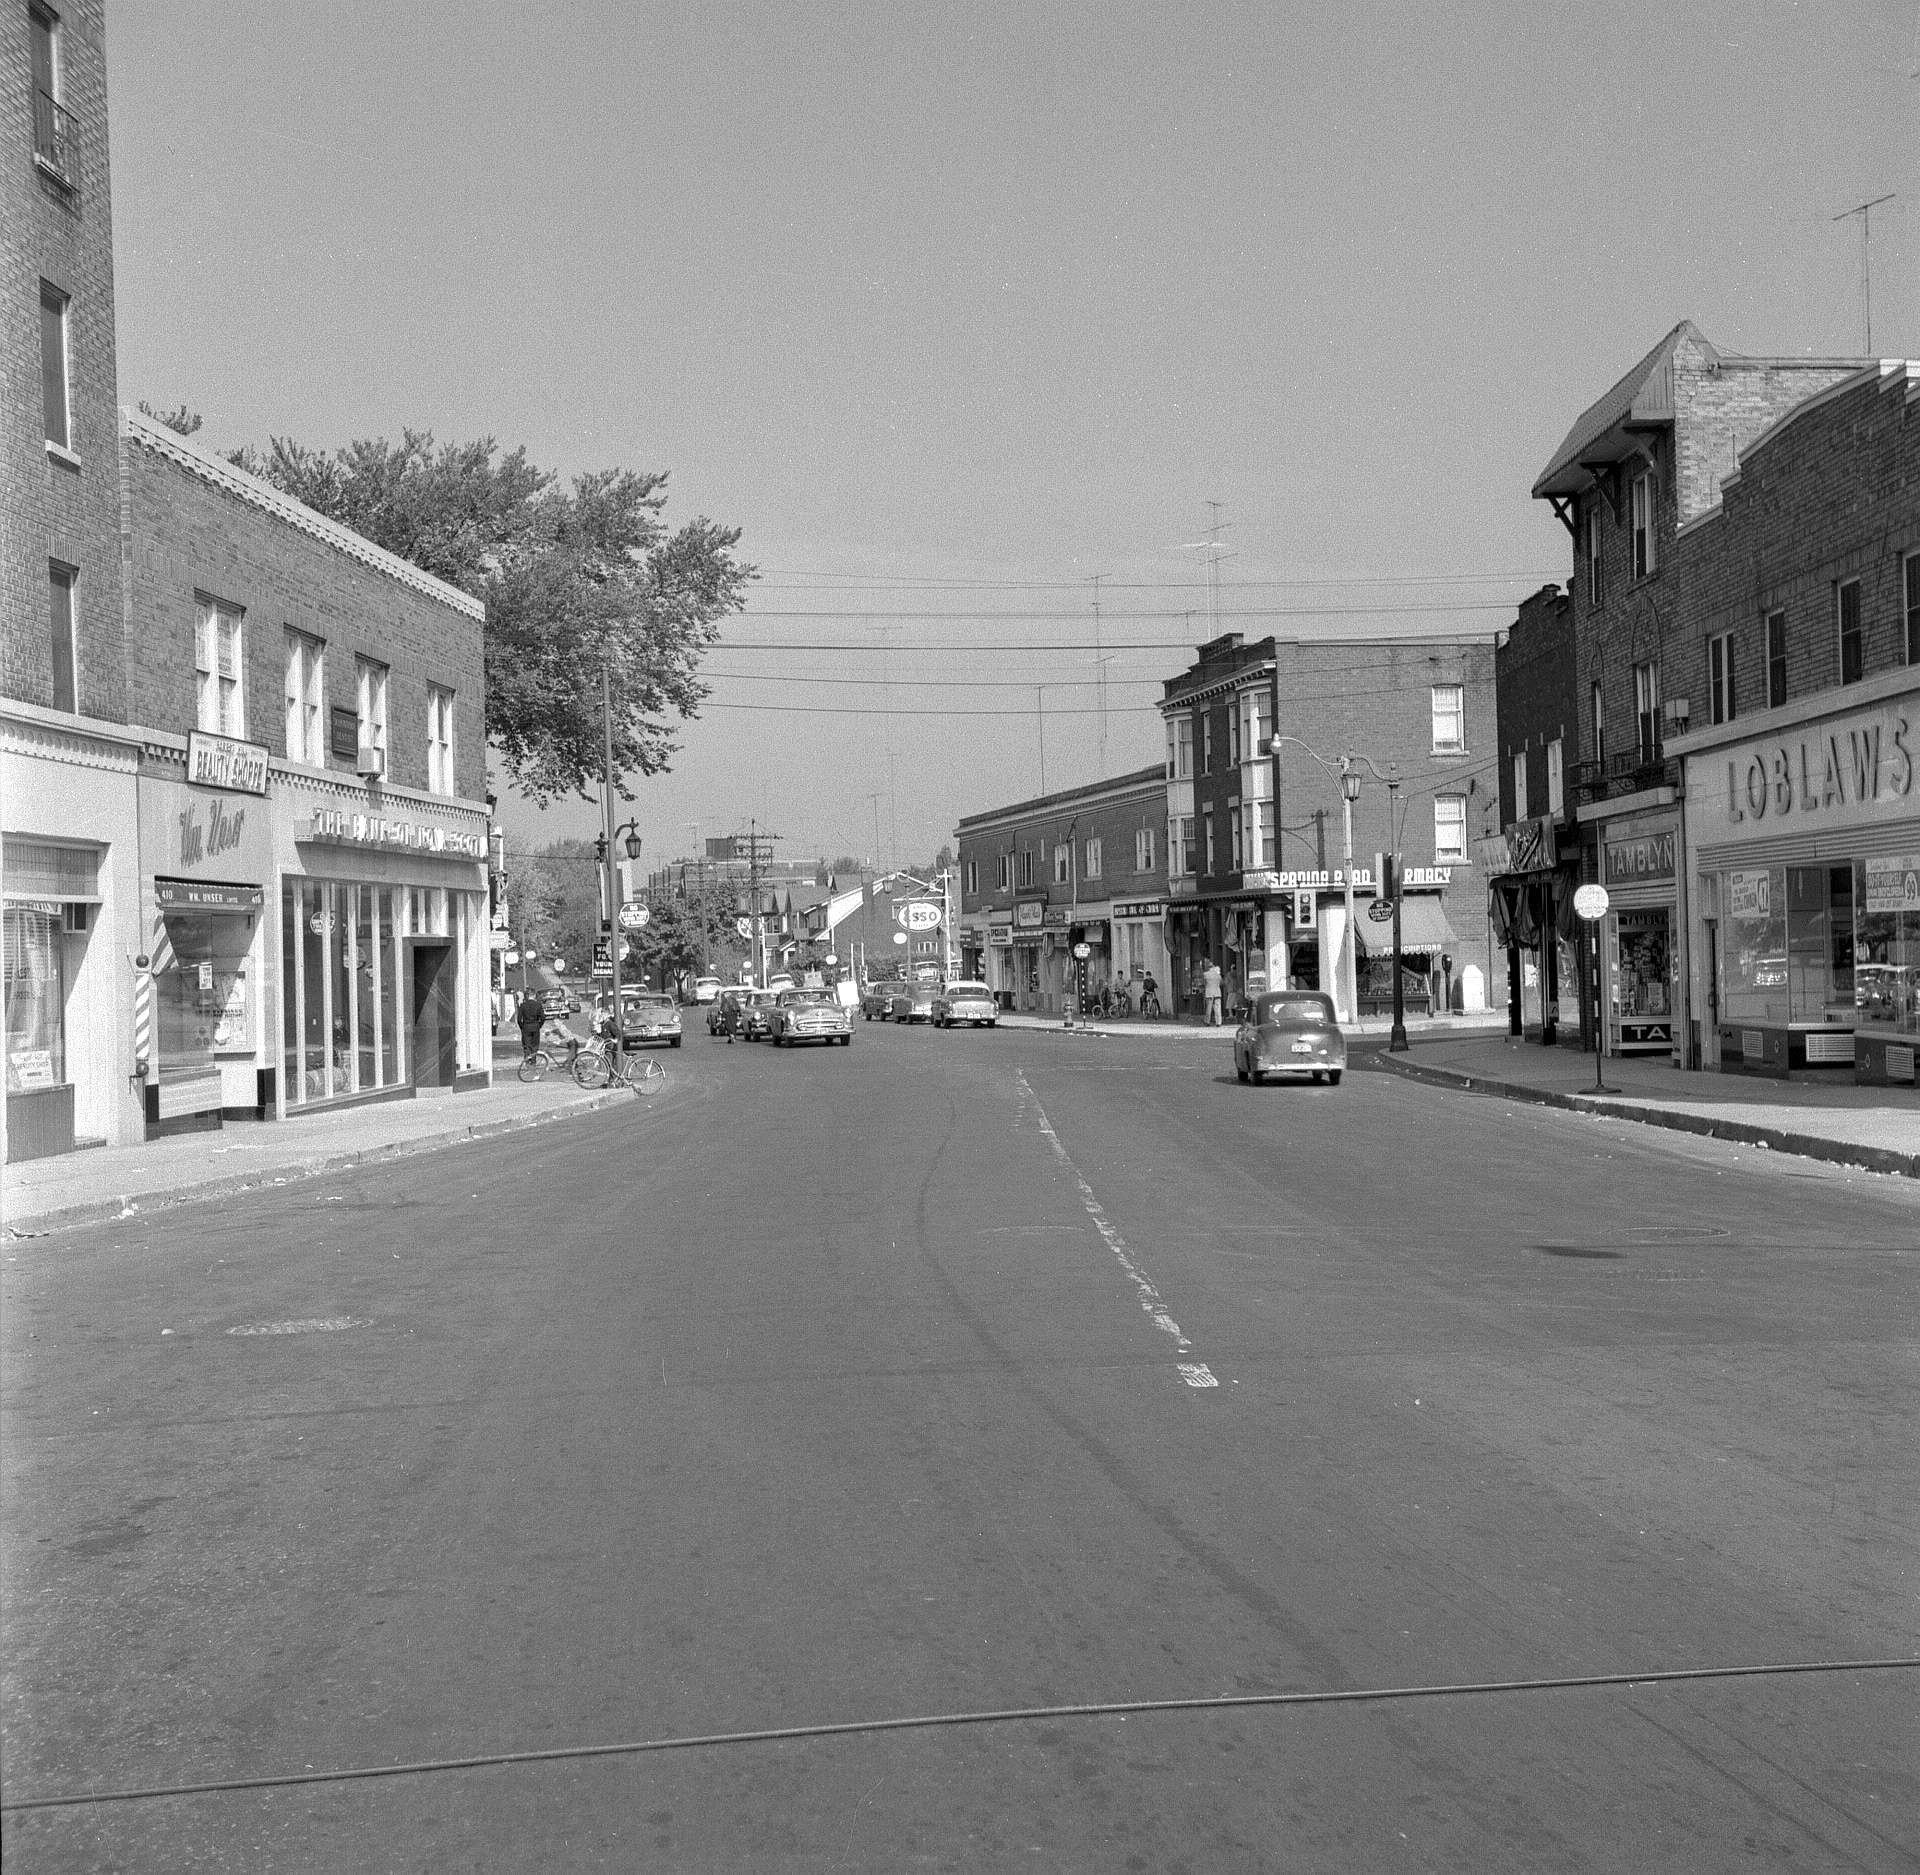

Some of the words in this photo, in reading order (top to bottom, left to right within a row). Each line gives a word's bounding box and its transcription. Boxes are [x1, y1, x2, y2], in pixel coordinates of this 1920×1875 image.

[196, 750, 230, 784] BEAUTY
[232, 757, 263, 791] SHOPPE
[1728, 718, 1912, 824] LOBLAWS
[313, 808, 342, 836] THE
[1609, 838, 1673, 875] TAMBLYN
[1270, 870, 1329, 887] SPADINA
[1333, 869, 1371, 885] RAD
[1404, 867, 1451, 884] RMACY
[161, 889, 173, 900] 410
[189, 892, 201, 902] WM.
[202, 893, 223, 902] UNSER
[1906, 879, 1915, 901] 99
[1384, 943, 1442, 954] PRCRIPTIONS
[1630, 1025, 1668, 1040] TA
